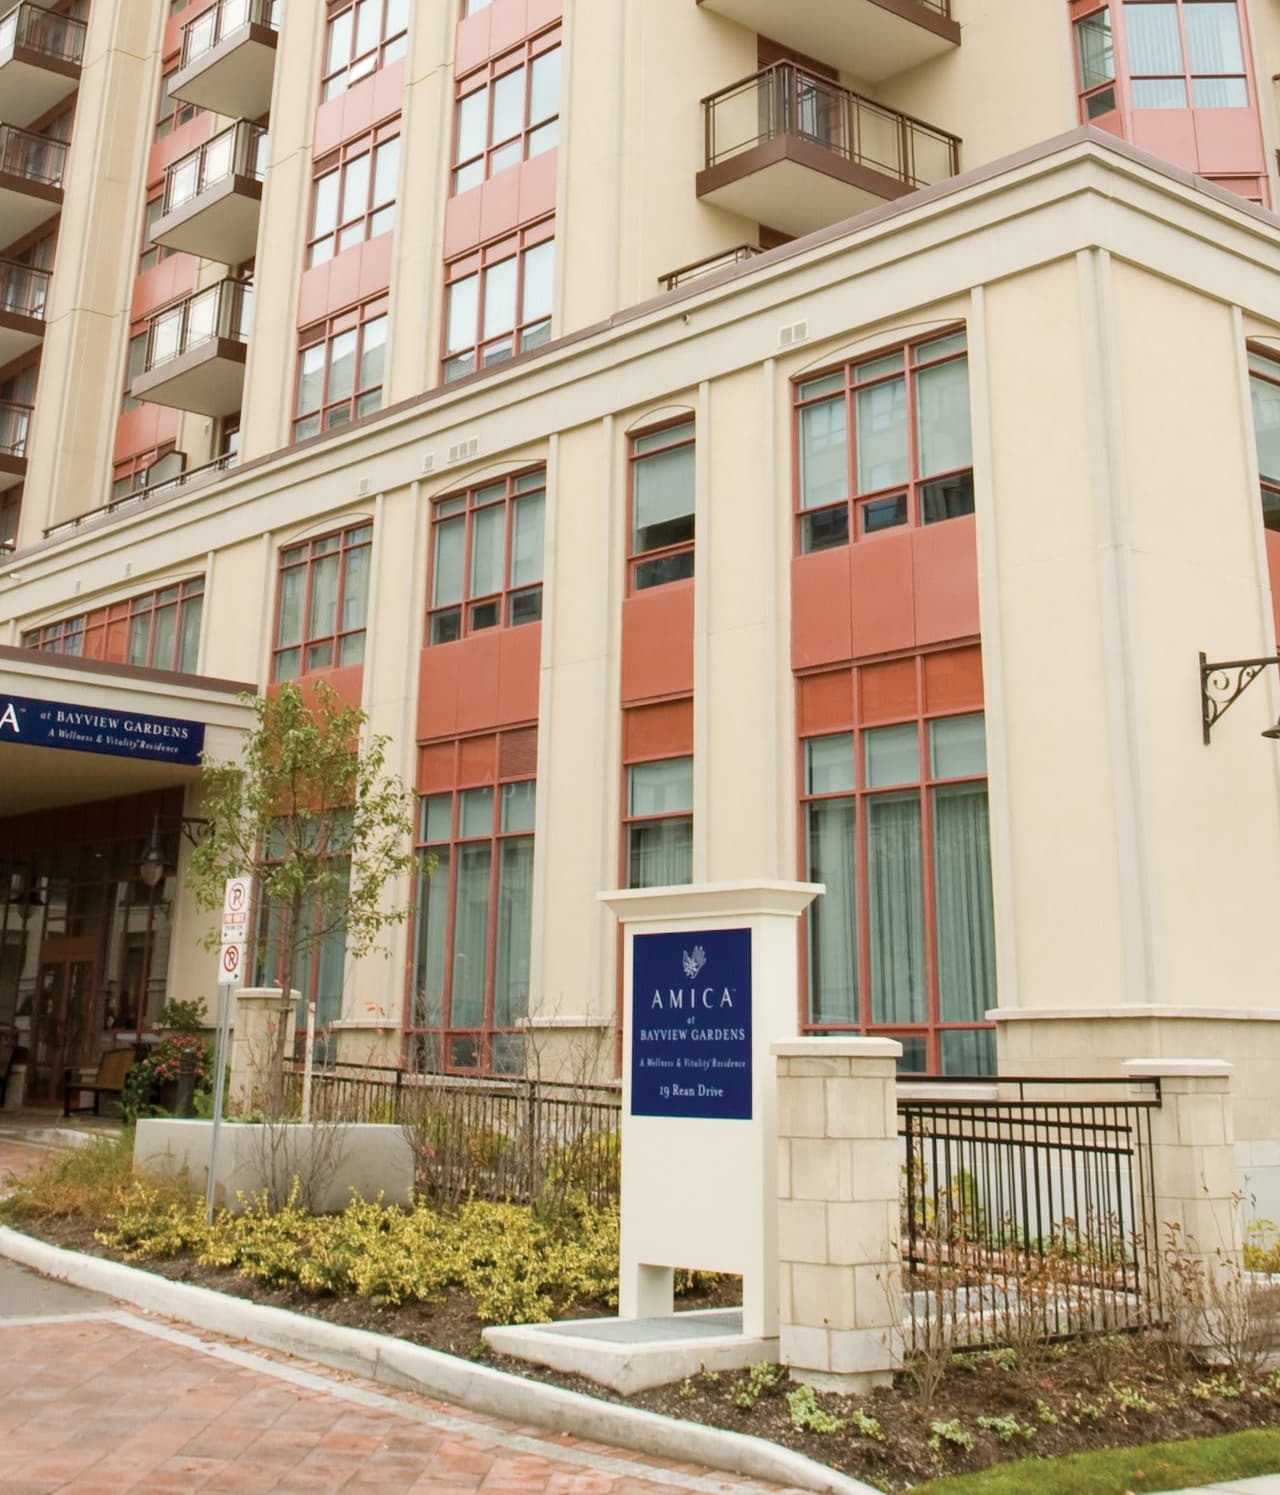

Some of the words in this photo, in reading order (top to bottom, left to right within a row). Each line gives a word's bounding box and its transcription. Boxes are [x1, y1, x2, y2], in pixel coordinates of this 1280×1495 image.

[40, 711, 51, 720] at
[56, 710, 120, 729] BAYVIEW
[123, 720, 189, 739] GARDENS
[48, 728, 55, 737] A
[58, 729, 93, 742] Wellness
[96, 734, 102, 744] &
[651, 988, 733, 1008] AMICA
[687, 1016, 695, 1024] at
[640, 1029, 688, 1041] BAYVIEW
[691, 1029, 745, 1041] GARDENS
[659, 1085, 670, 1099] 19
[672, 1083, 695, 1096] Rean
[698, 1084, 724, 1097] Drive
